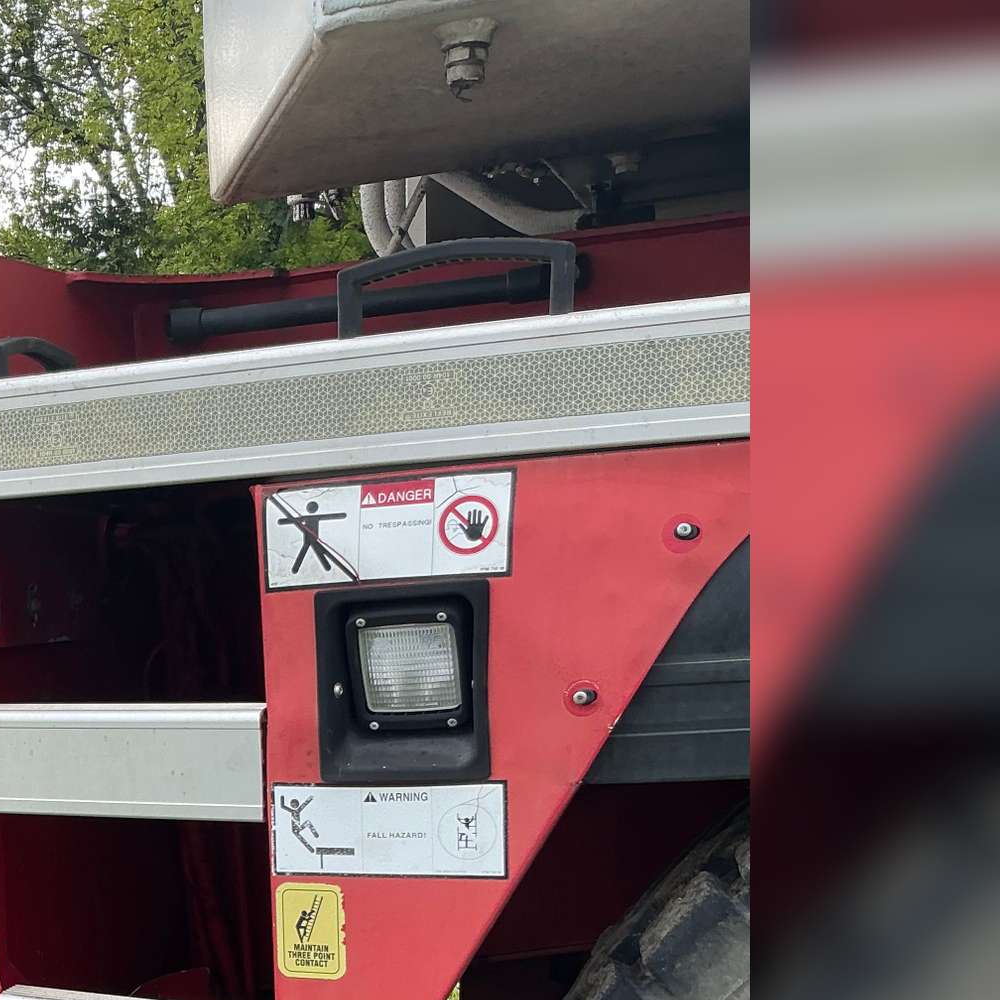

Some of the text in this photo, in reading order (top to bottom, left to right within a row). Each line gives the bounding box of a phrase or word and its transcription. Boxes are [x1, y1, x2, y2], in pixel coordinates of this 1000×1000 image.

[378, 488, 432, 504] DANGER
[379, 792, 428, 802] WARNING
[294, 944, 329, 952] MAINTAIN
[288, 951, 335, 960] THREE POINT
[295, 959, 328, 967] CONTACT
